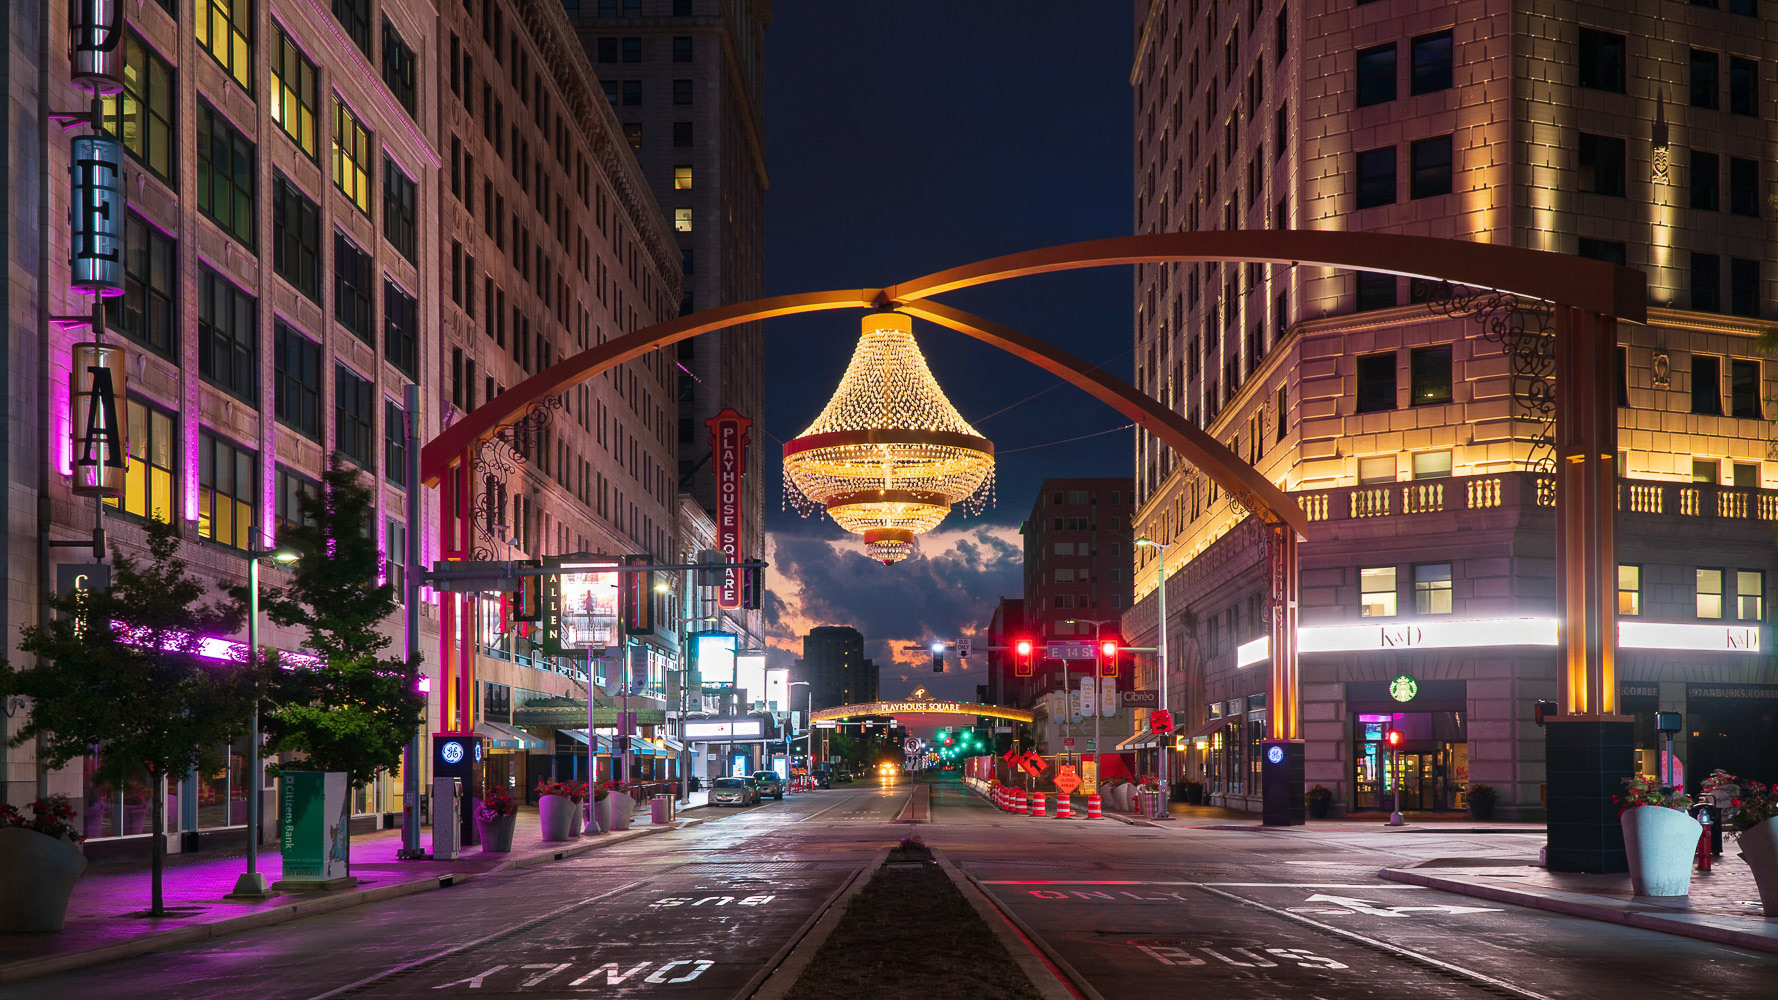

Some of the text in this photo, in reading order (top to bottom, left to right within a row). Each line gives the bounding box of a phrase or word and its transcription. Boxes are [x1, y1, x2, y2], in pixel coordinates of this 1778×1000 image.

[723, 427, 735, 526] PLAYHOUSE
[549, 573, 558, 639] ALLEN
[1051, 647, 1094, 658] E. 14 St
[1688, 687, 1746, 698] STARBUCKS
[881, 703, 960, 711] PLAYHOUSE SQUARE
[285, 785, 295, 849] Citizens Bank
[648, 895, 776, 907] BUS
[1028, 890, 1188, 901] ONLY
[1136, 945, 1349, 969] BUS
[431, 959, 716, 989] ONLY
